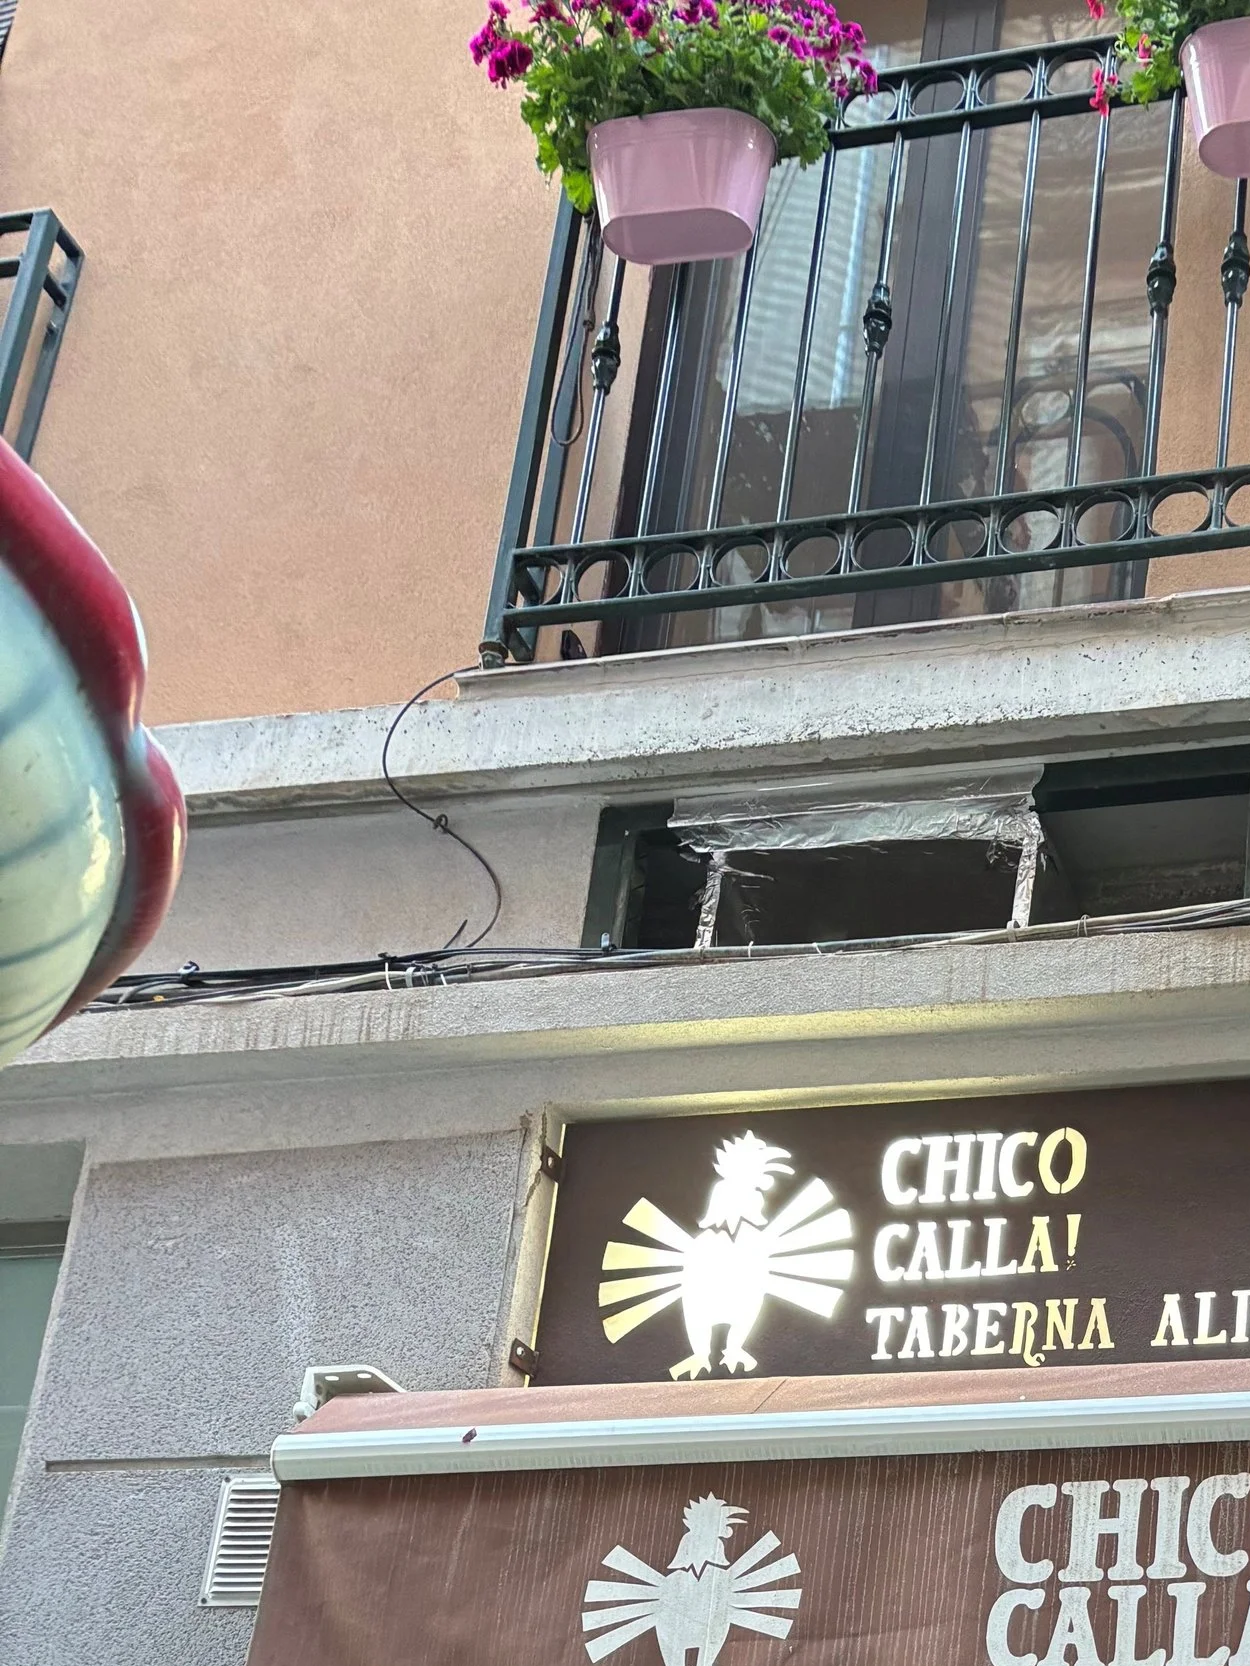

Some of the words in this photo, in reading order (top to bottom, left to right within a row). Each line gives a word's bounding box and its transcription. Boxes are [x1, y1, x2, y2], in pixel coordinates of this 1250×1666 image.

[881, 1126, 1088, 1206] CHICO
[874, 1214, 1082, 1282] CALLA!
[866, 1296, 1115, 1366] TABERNA
